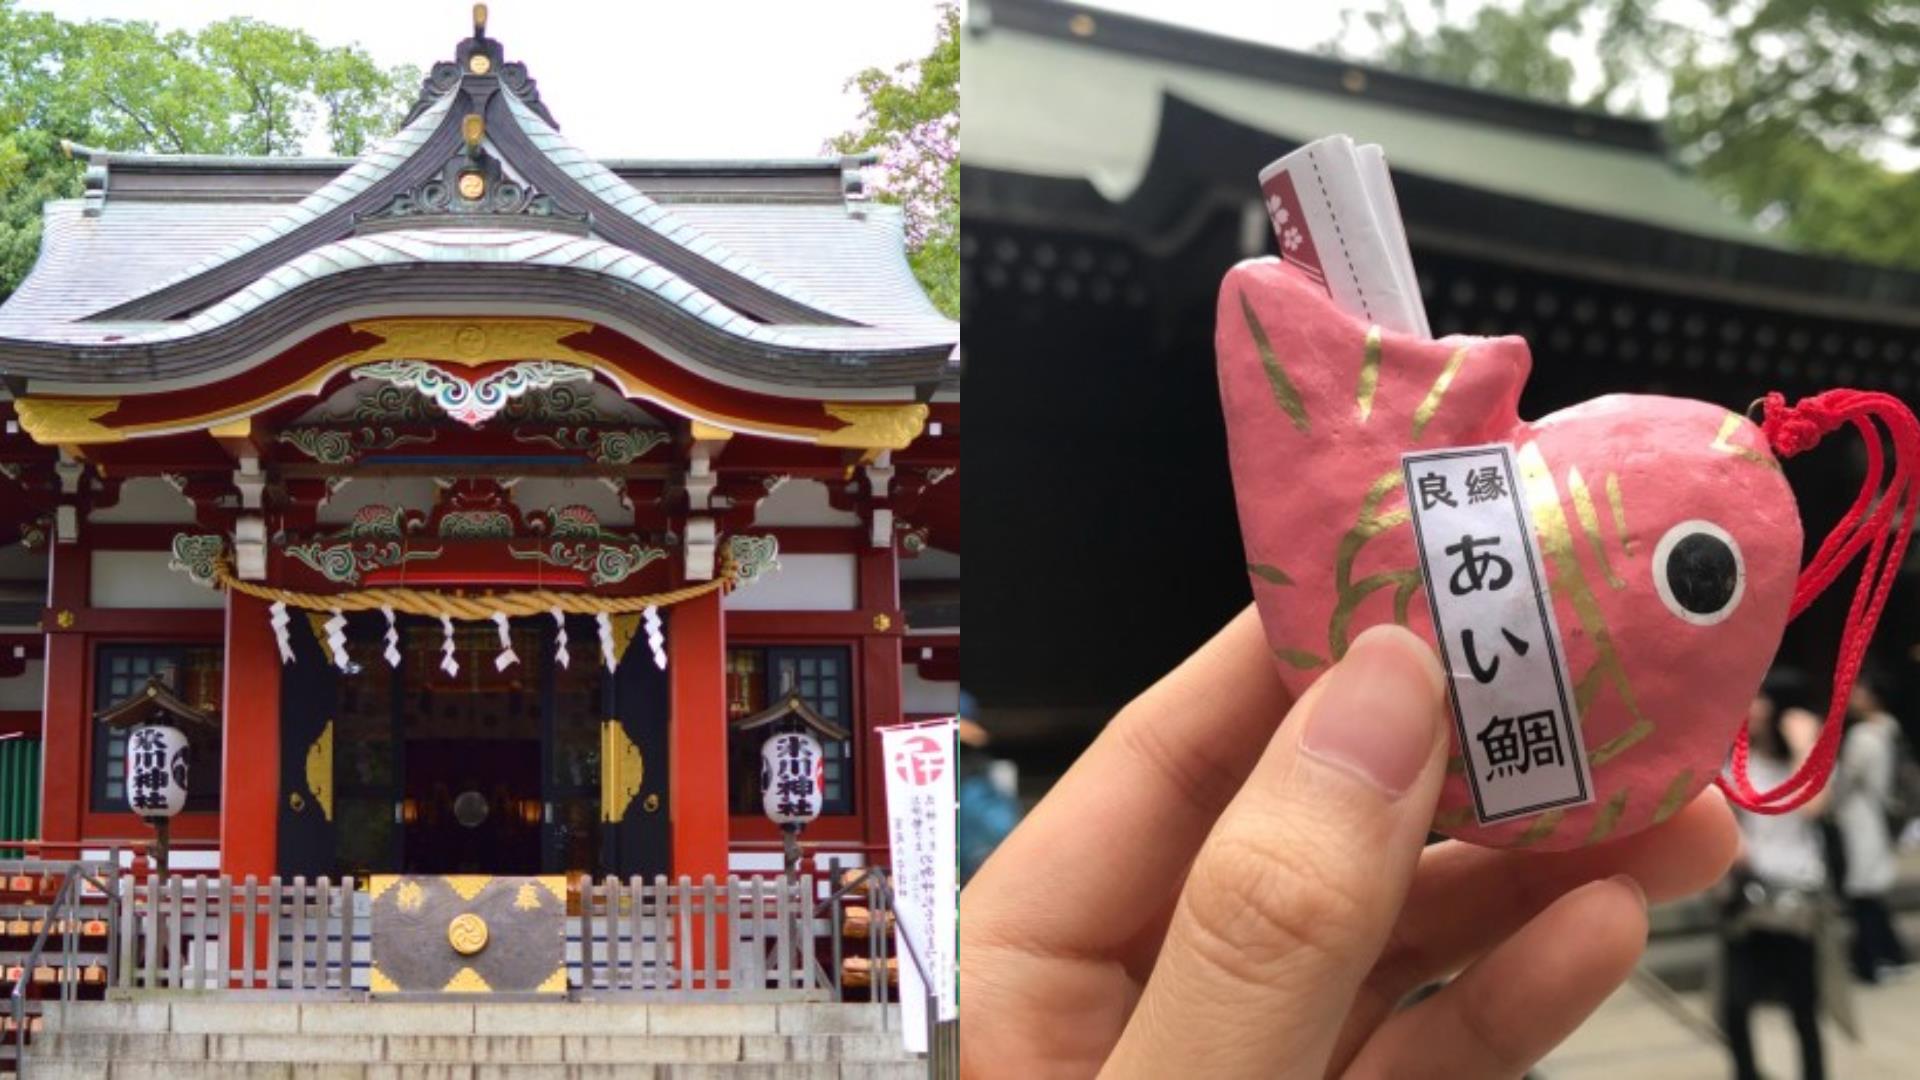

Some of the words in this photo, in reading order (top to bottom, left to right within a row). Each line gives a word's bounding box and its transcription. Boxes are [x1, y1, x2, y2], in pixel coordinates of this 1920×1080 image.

[1418, 466, 1508, 510] 良縁
[1445, 533, 1565, 782] あい鯛
[133, 729, 169, 809] 氷川神社
[776, 736, 813, 816] 氷川神社
